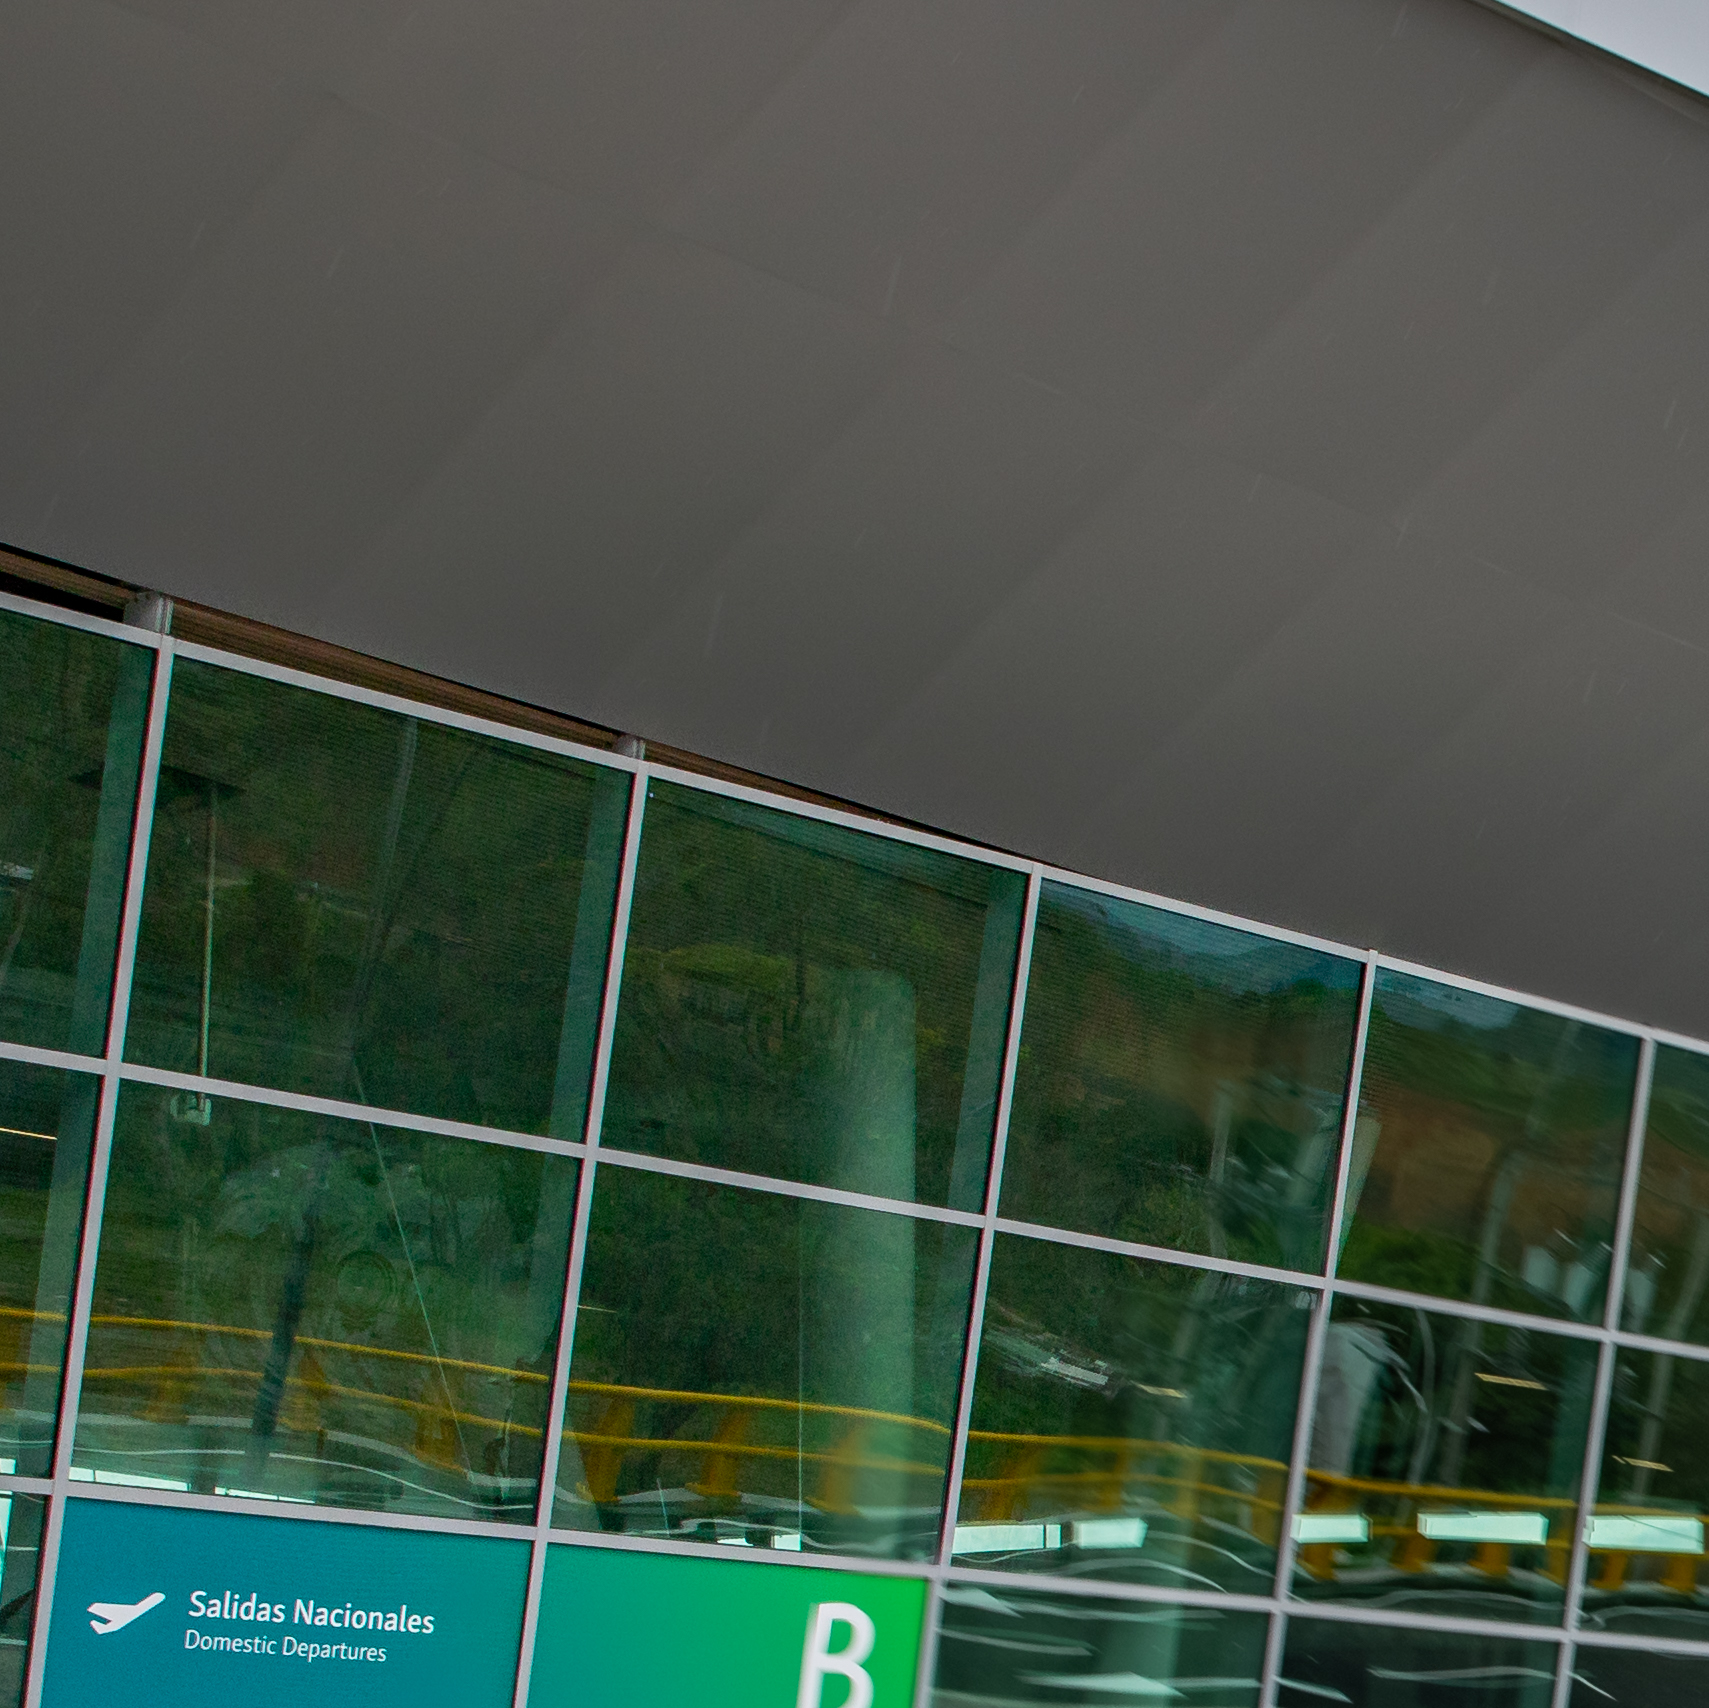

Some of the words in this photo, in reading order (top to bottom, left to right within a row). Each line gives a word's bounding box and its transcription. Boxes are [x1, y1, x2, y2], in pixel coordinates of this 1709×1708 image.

[188, 1590, 286, 1624] Salidas
[293, 1598, 435, 1634] Nacionales
[184, 1629, 277, 1655] Domestic
[282, 1636, 387, 1663] Departures
